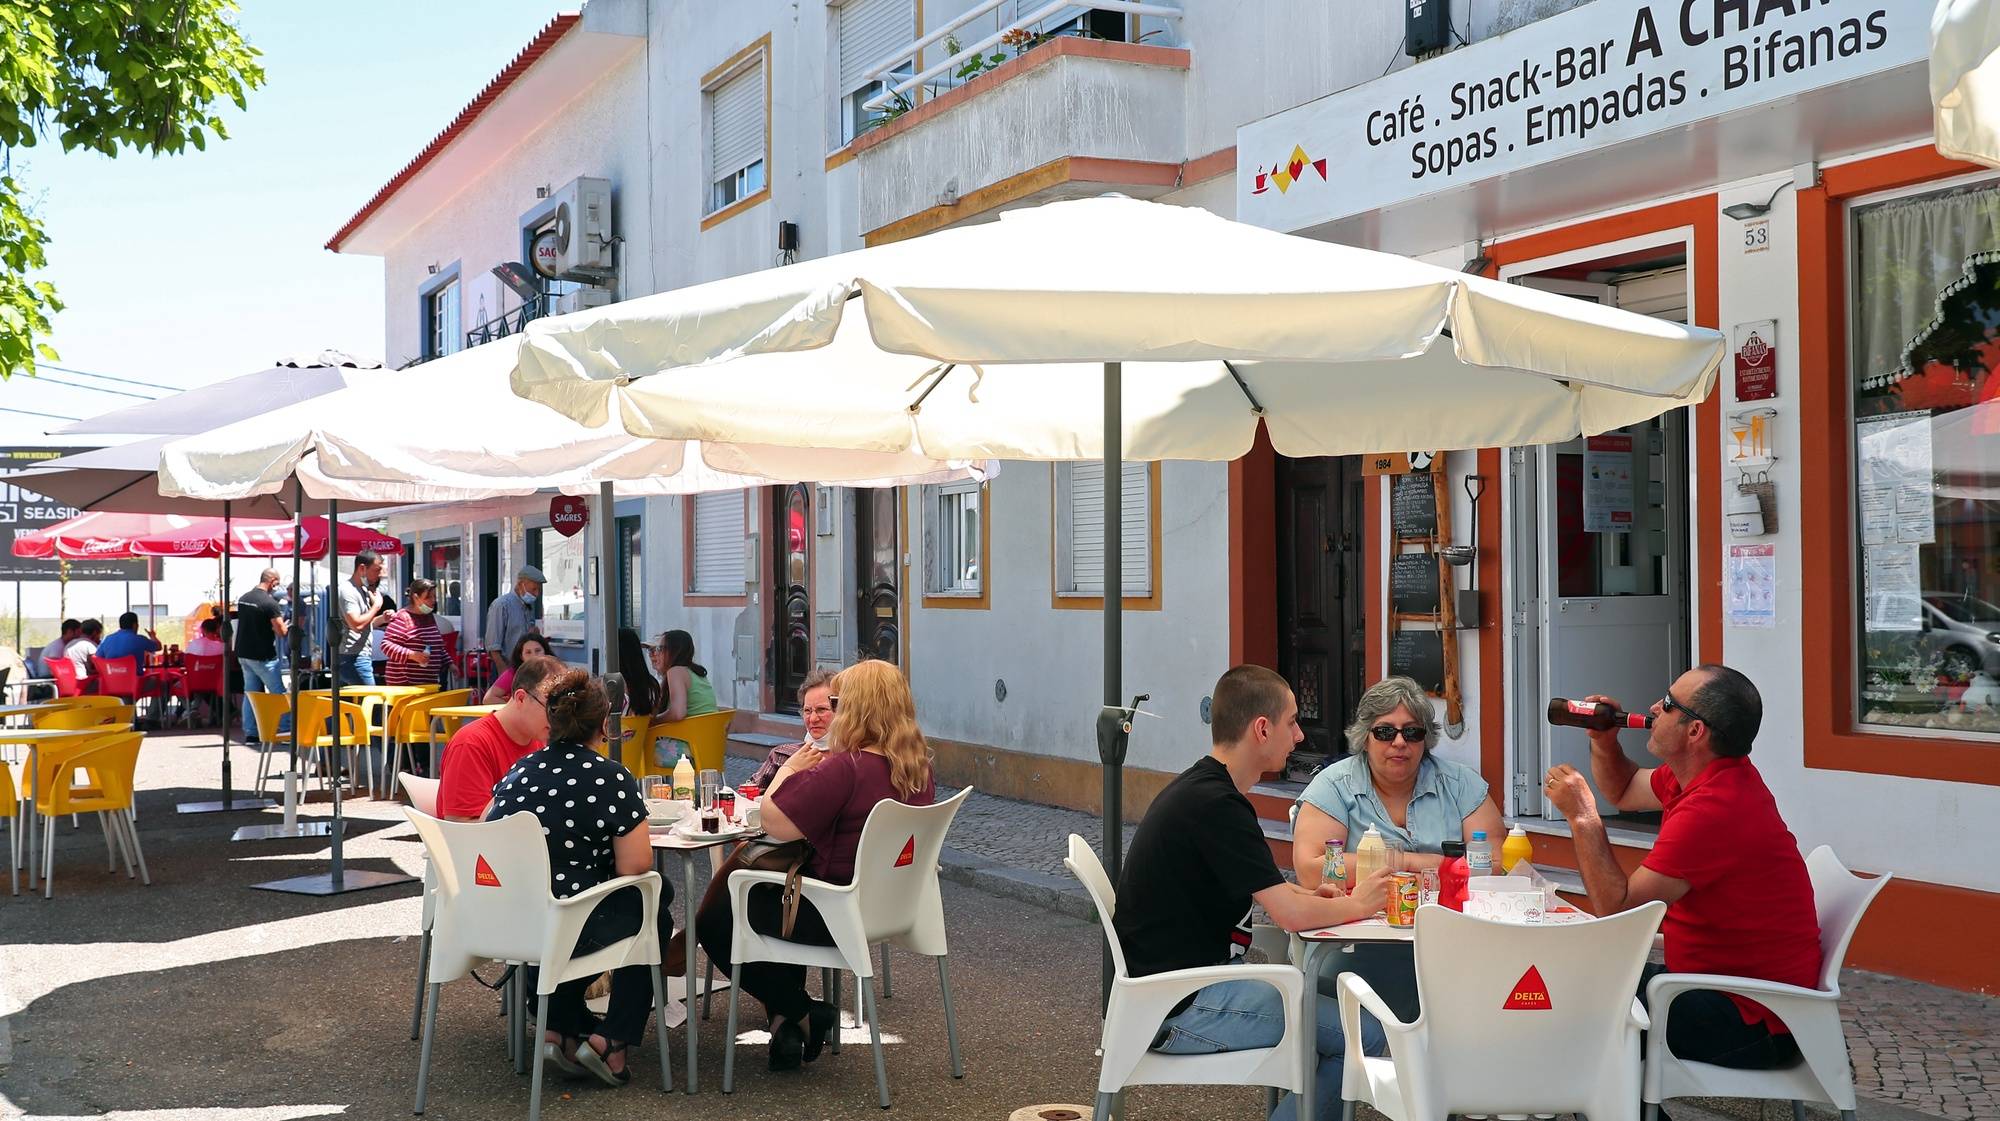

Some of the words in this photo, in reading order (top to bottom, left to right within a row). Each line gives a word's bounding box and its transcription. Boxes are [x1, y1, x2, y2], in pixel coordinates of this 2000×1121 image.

[1366, 95, 1425, 147] Café
[1451, 39, 1614, 121] Snack-Bar
[1625, 6, 1664, 67] A
[1412, 126, 1497, 179] Sopas
[1527, 69, 1687, 147] Empadas
[1723, 9, 1888, 91] Bifanas
[1744, 228, 1768, 247] 53
[1375, 458, 1392, 470] 1984
[23, 506, 83, 520] SEASID
[554, 512, 583, 523] SAGRES
[1514, 992, 1545, 1001] DELTA
